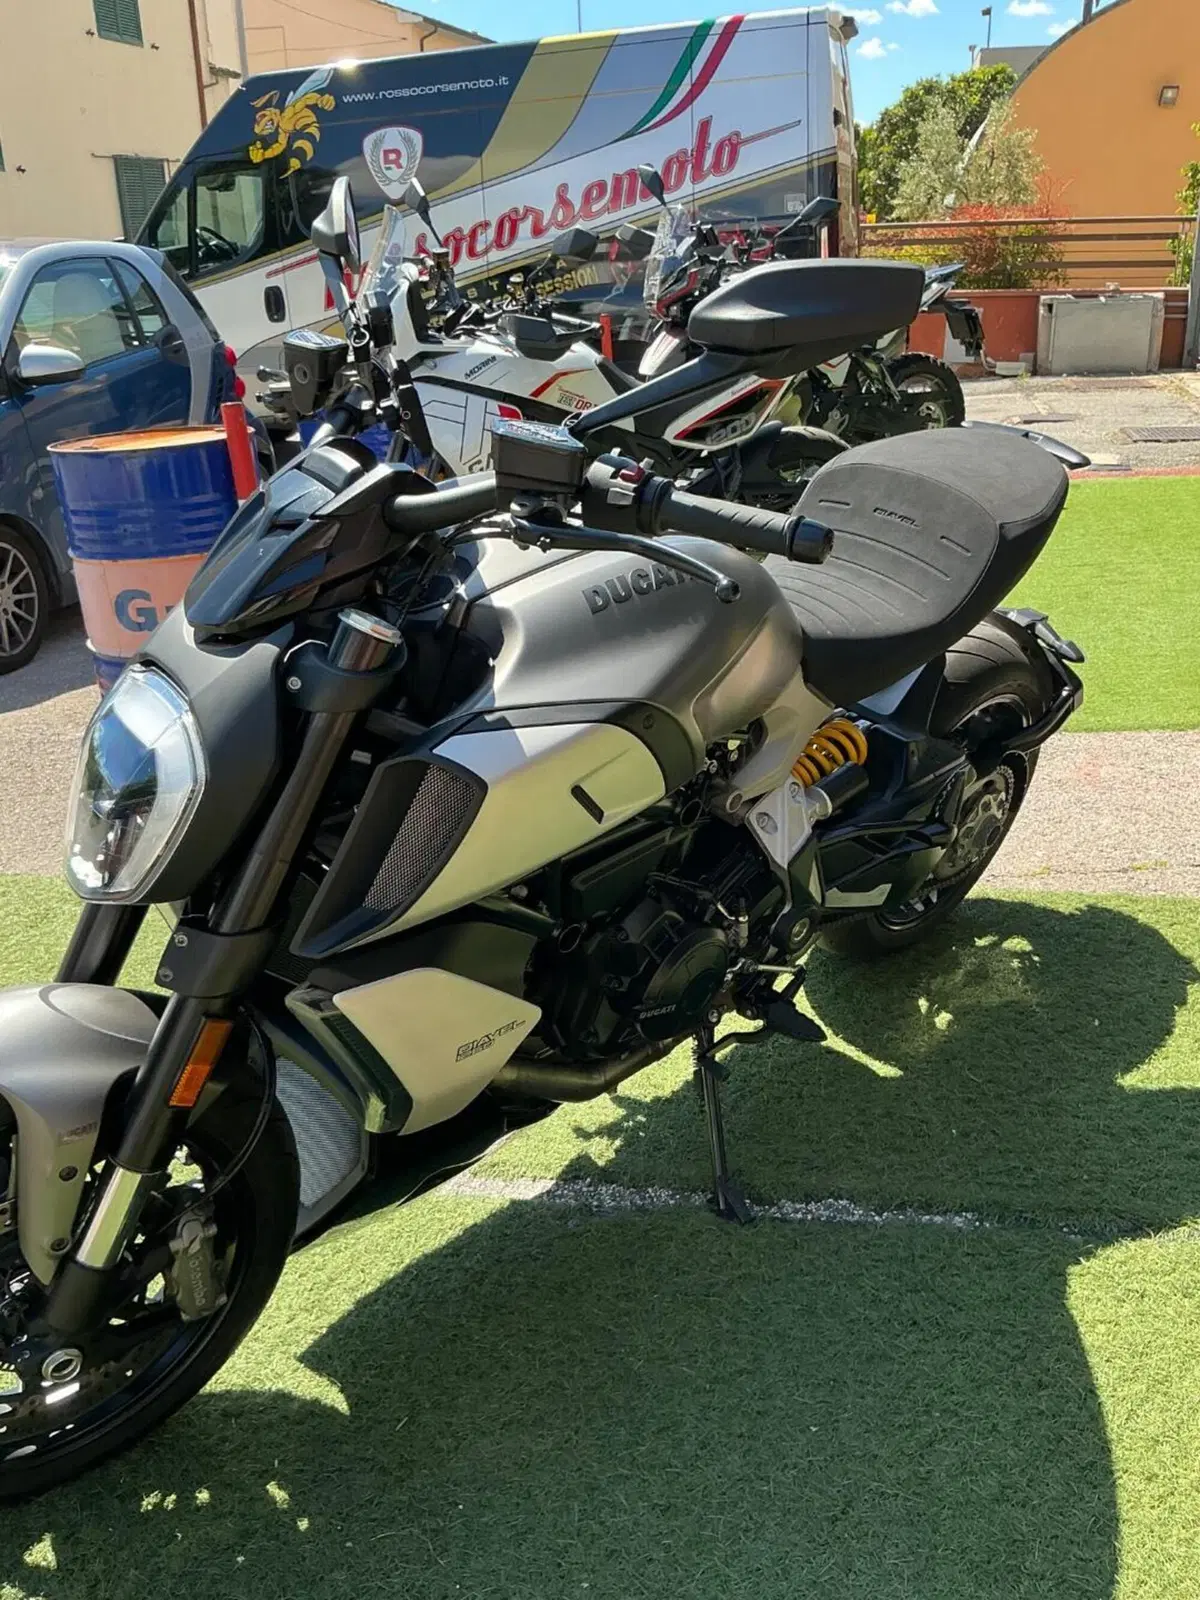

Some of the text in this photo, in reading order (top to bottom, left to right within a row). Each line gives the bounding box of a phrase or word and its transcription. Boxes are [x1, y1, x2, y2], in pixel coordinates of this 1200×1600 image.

[342, 75, 509, 103] www.rossocorsemoto.it
[382, 148, 403, 170] R
[581, 562, 693, 616] DUCAT
[639, 1004, 677, 1020] DUCATI
